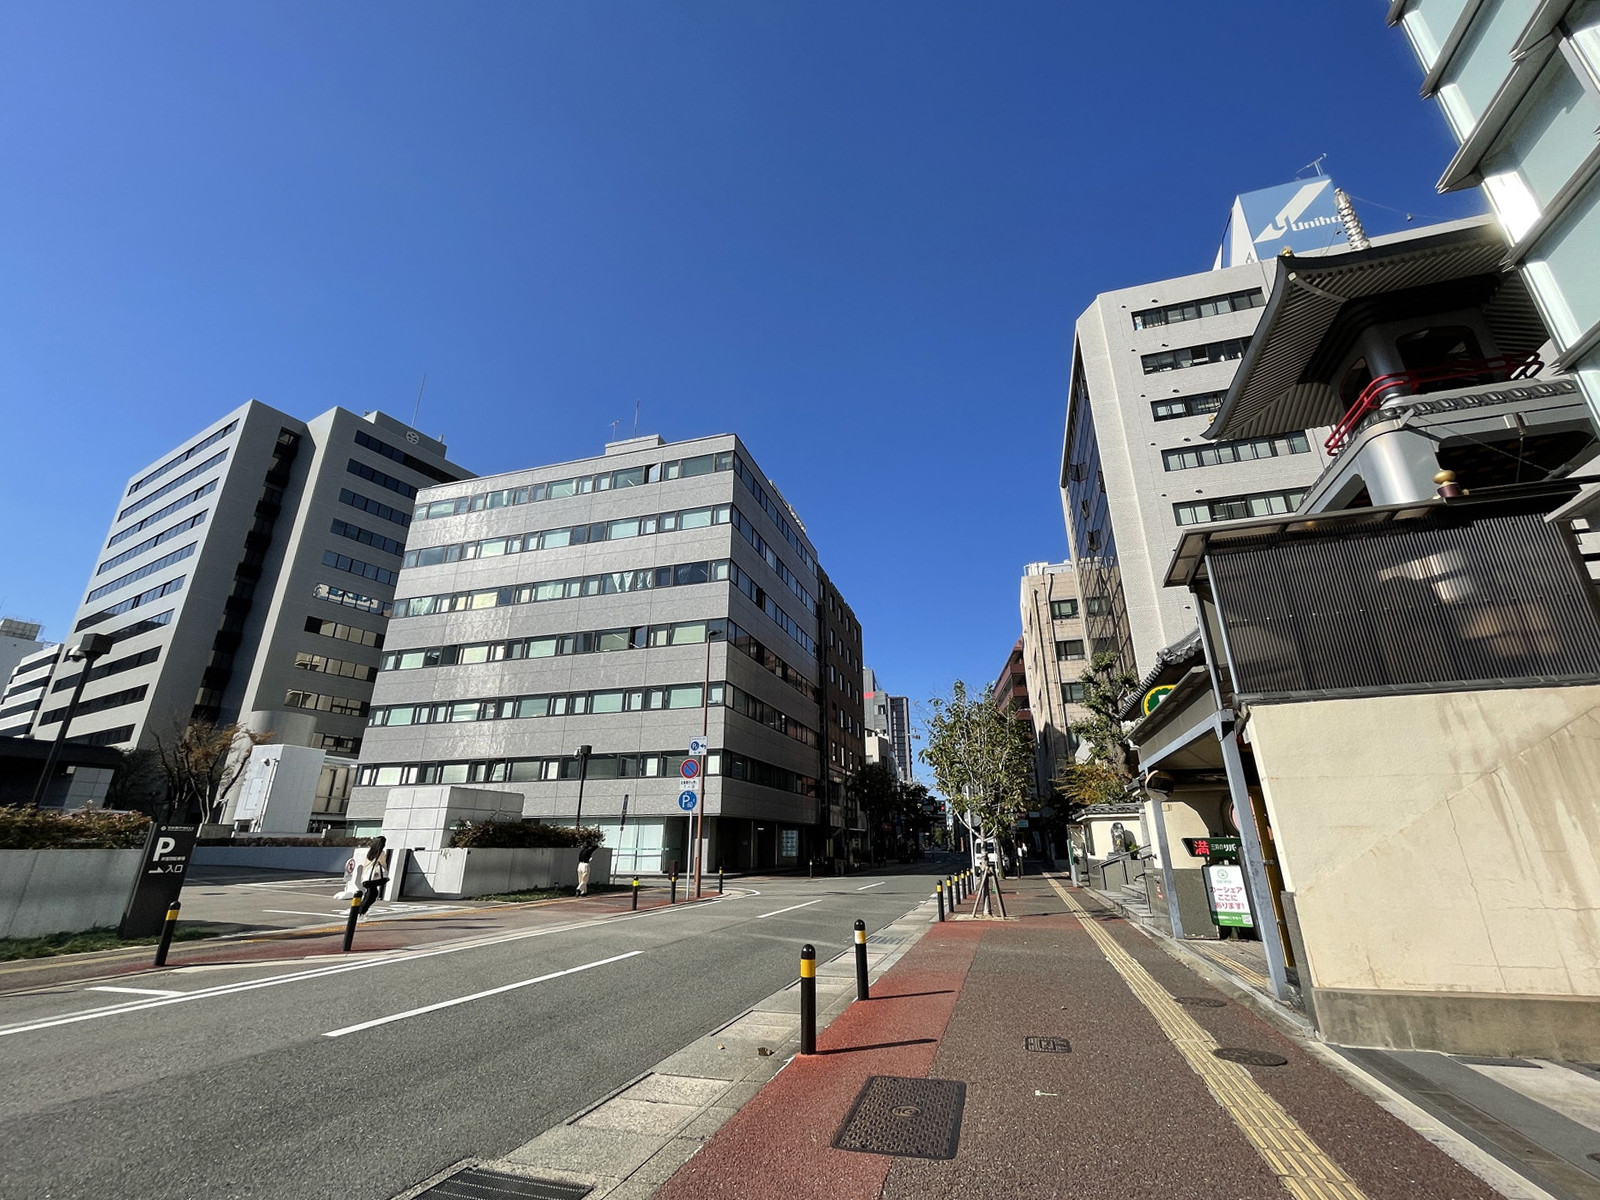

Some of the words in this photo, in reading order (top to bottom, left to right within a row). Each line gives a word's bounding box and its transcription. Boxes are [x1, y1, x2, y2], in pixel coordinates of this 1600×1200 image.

[682, 795, 690, 808] P
[153, 837, 175, 861] P
[1194, 840, 1209, 855] 満
[165, 864, 183, 873] 入口
